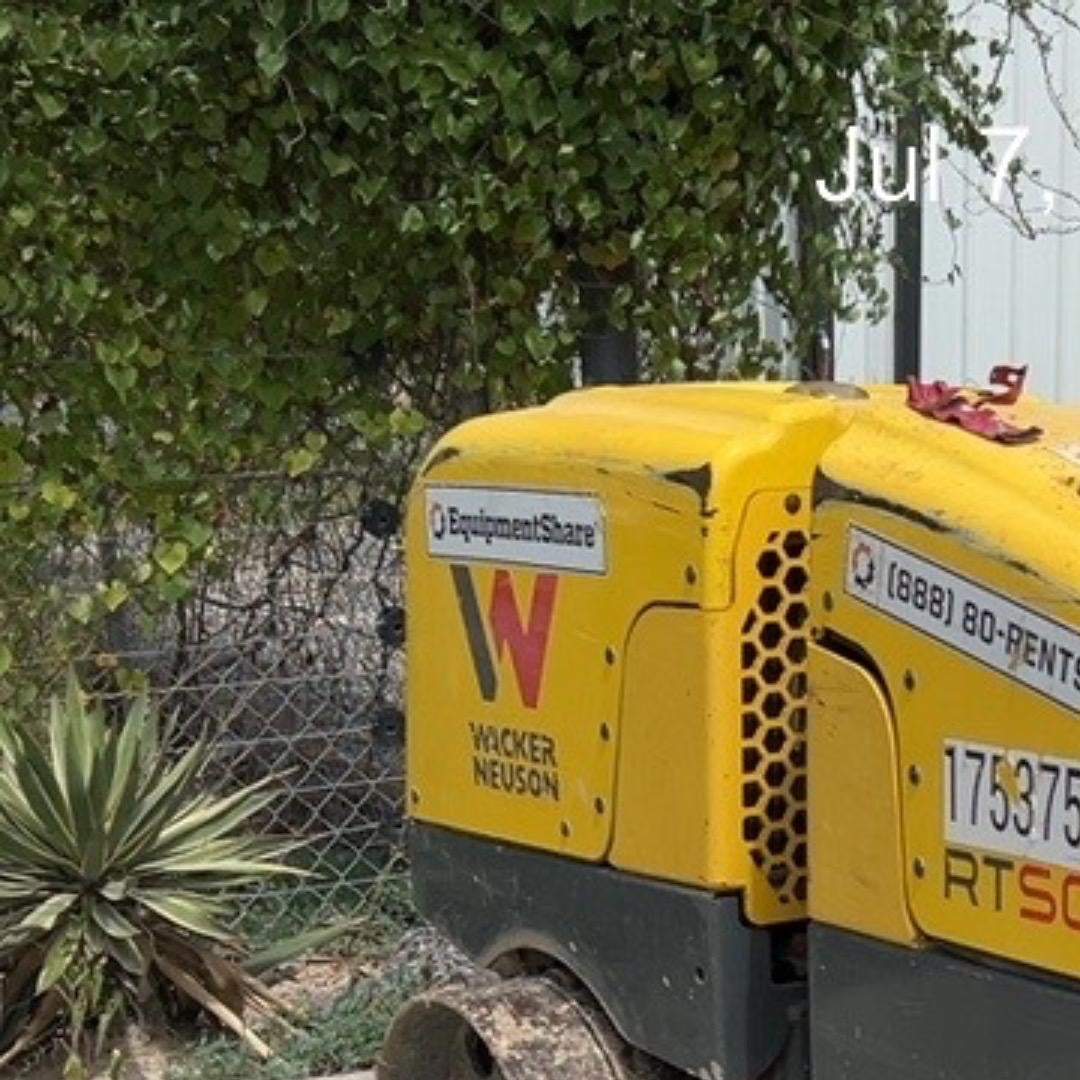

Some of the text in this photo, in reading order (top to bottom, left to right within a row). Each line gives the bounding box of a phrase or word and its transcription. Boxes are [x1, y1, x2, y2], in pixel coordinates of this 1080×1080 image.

[449, 505, 598, 548] EquipmentShare
[886, 561, 955, 626] (888)
[467, 722, 558, 767] WACKER
[471, 756, 561, 801] NEUSON
